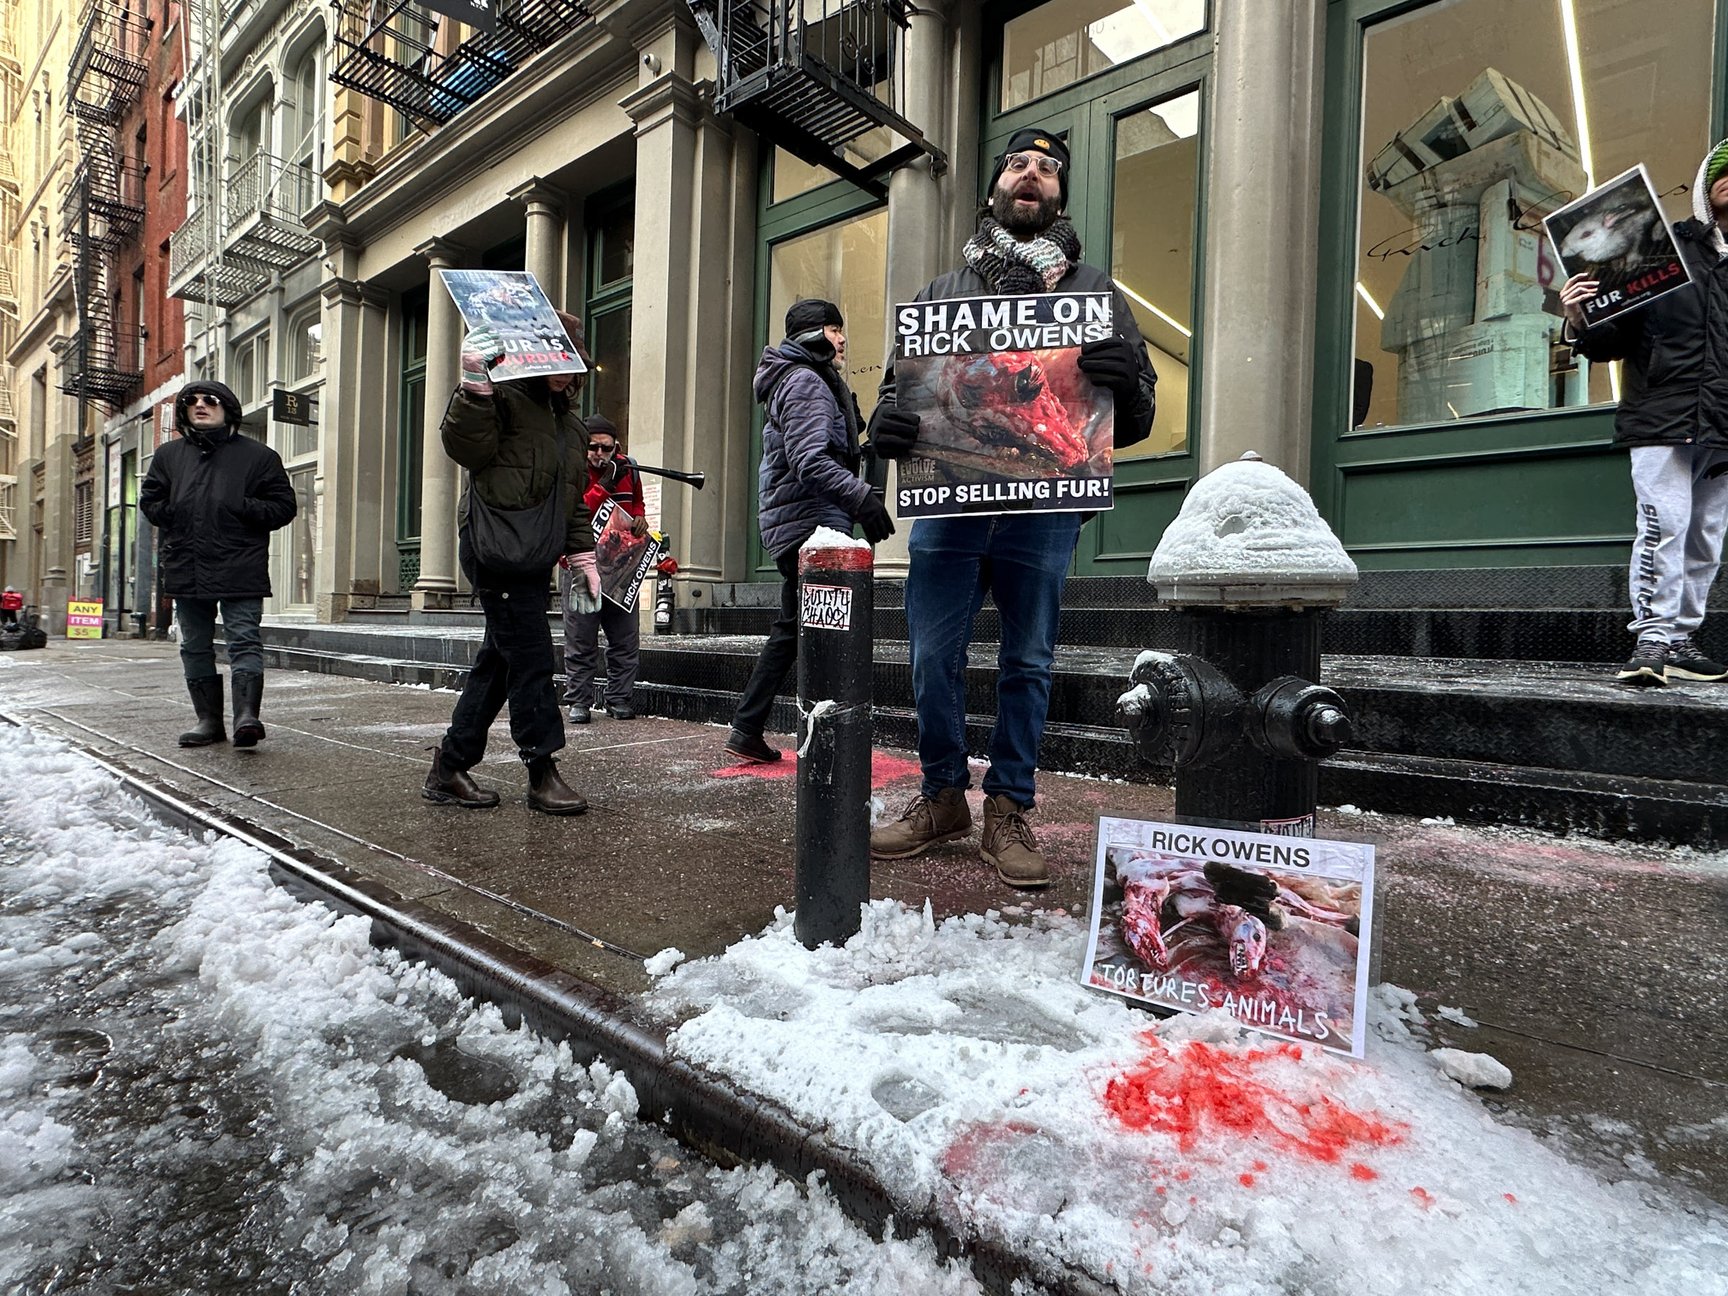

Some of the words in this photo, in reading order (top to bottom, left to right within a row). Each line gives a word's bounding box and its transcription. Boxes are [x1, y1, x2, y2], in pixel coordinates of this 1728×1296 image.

[1585, 290, 1622, 313] FUR
[1626, 262, 1681, 295] KILLS
[898, 299, 1037, 335] SHAME
[1053, 296, 1110, 323] ON
[503, 339, 535, 353] UR
[541, 338, 564, 351] IS
[904, 330, 972, 357] RICK
[990, 324, 1104, 351] OWENS
[495, 350, 573, 366] MURDER
[286, 394, 298, 408] R
[901, 458, 936, 476] EVOLVE
[901, 474, 935, 484] ACTIVISM
[899, 486, 951, 507] STOP
[955, 481, 1050, 503] SELLING
[1056, 479, 1110, 498] FUR!
[600, 499, 615, 521] ON
[623, 579, 639, 606] RICK
[636, 541, 657, 580] OWENS
[73, 605, 98, 614] ANY
[71, 616, 99, 625] ITEM
[74, 627, 89, 636] $5
[1152, 830, 1207, 857] RICK
[1212, 837, 1311, 868] OWENS
[1101, 963, 1211, 1009] TORTURES
[1222, 992, 1329, 1040] ANIMALS
